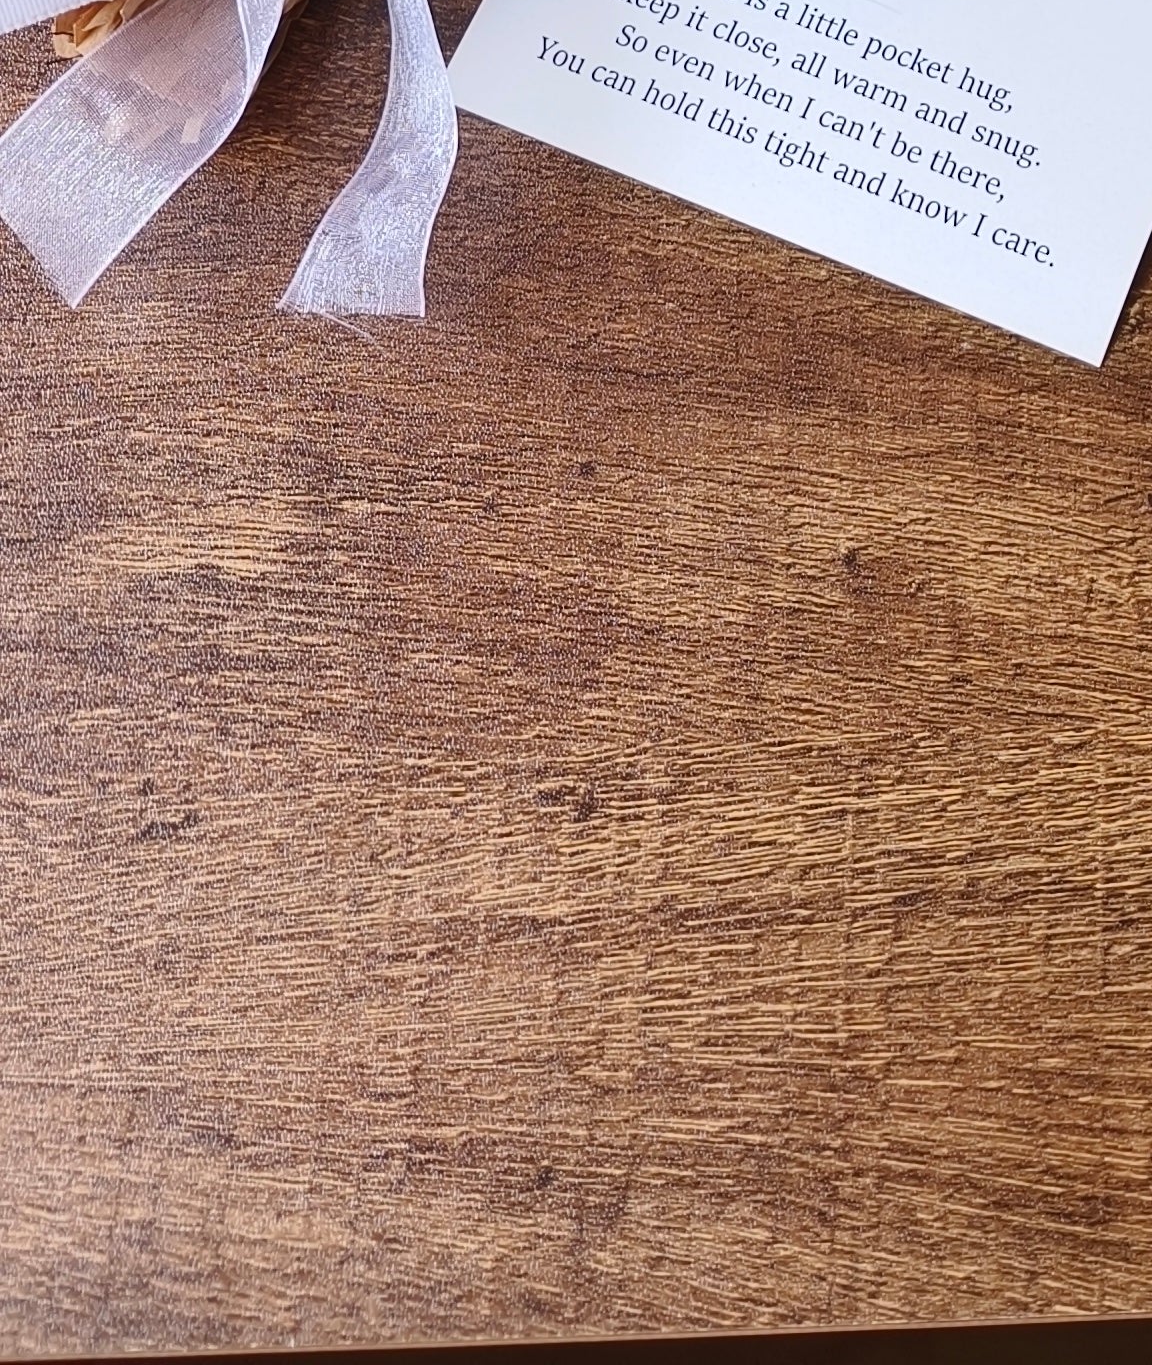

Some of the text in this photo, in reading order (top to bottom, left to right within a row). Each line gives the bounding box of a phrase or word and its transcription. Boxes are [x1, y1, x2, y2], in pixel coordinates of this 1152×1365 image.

[616, 25, 1004, 203] So even when I can't be there,
[685, 6, 708, 31] it
[713, 20, 780, 67] close,
[791, 52, 827, 78] all
[834, 68, 907, 112] warm
[915, 103, 968, 134] and
[971, 126, 1040, 168] snug.
[774, 2, 789, 20] a
[796, 4, 858, 46] little
[861, 37, 954, 84] pocket
[957, 67, 1012, 113] hug,
[537, 36, 1053, 267] You can hold this tight and know I care.
